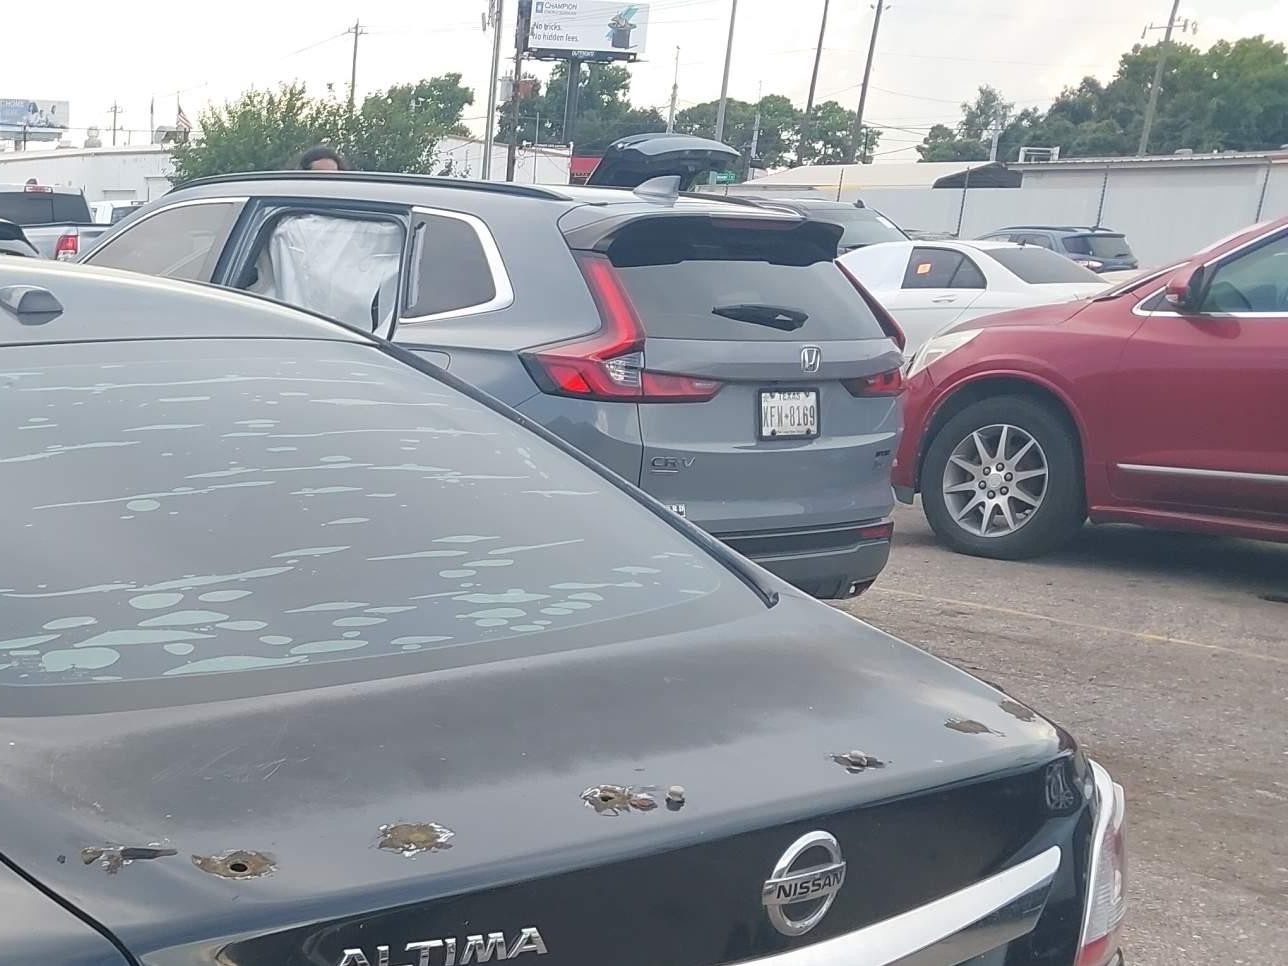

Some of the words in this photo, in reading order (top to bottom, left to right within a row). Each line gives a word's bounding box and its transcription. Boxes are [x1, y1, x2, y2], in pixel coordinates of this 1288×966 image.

[545, 2, 577, 10] CHAMPION
[543, 33, 564, 41] hidden
[775, 871, 844, 902] NISSAN
